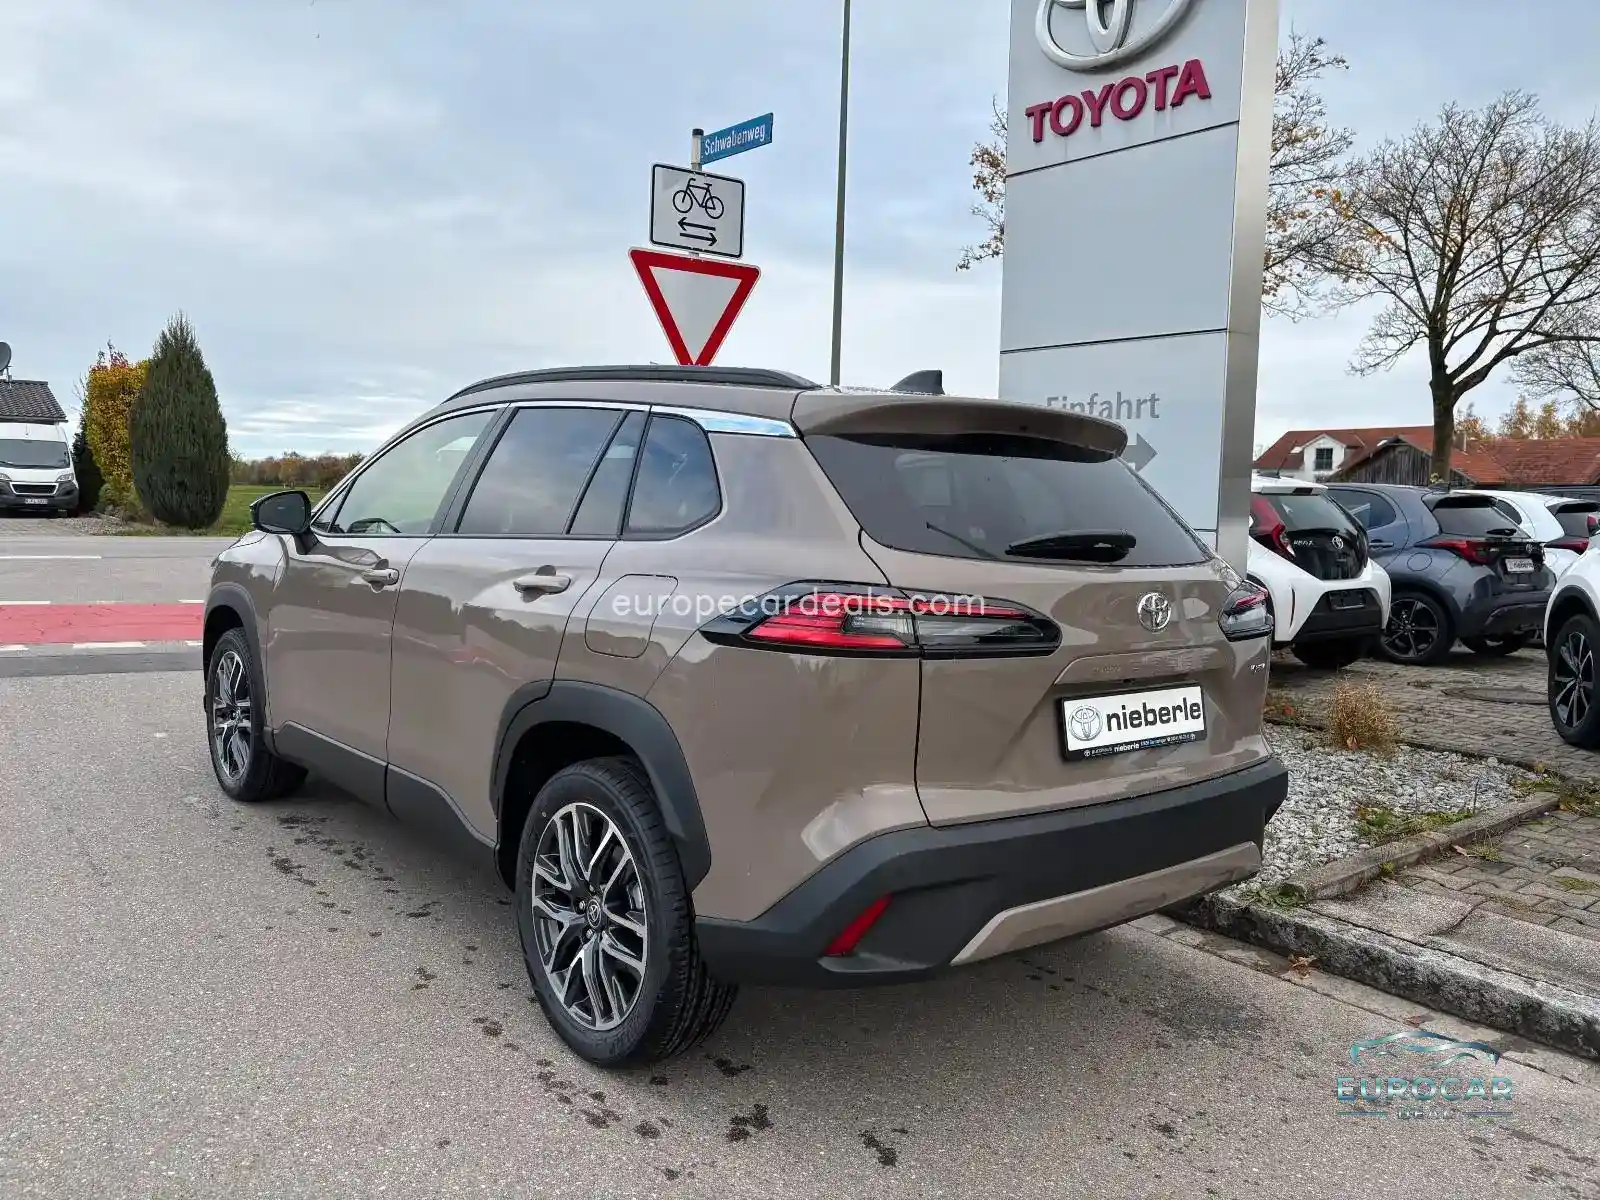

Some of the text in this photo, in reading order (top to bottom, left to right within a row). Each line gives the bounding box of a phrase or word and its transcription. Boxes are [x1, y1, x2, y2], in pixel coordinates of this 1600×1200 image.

[1025, 58, 1211, 142] TOYOTA
[704, 124, 765, 155] Schwabenweg
[1106, 697, 1202, 731] nieberle
